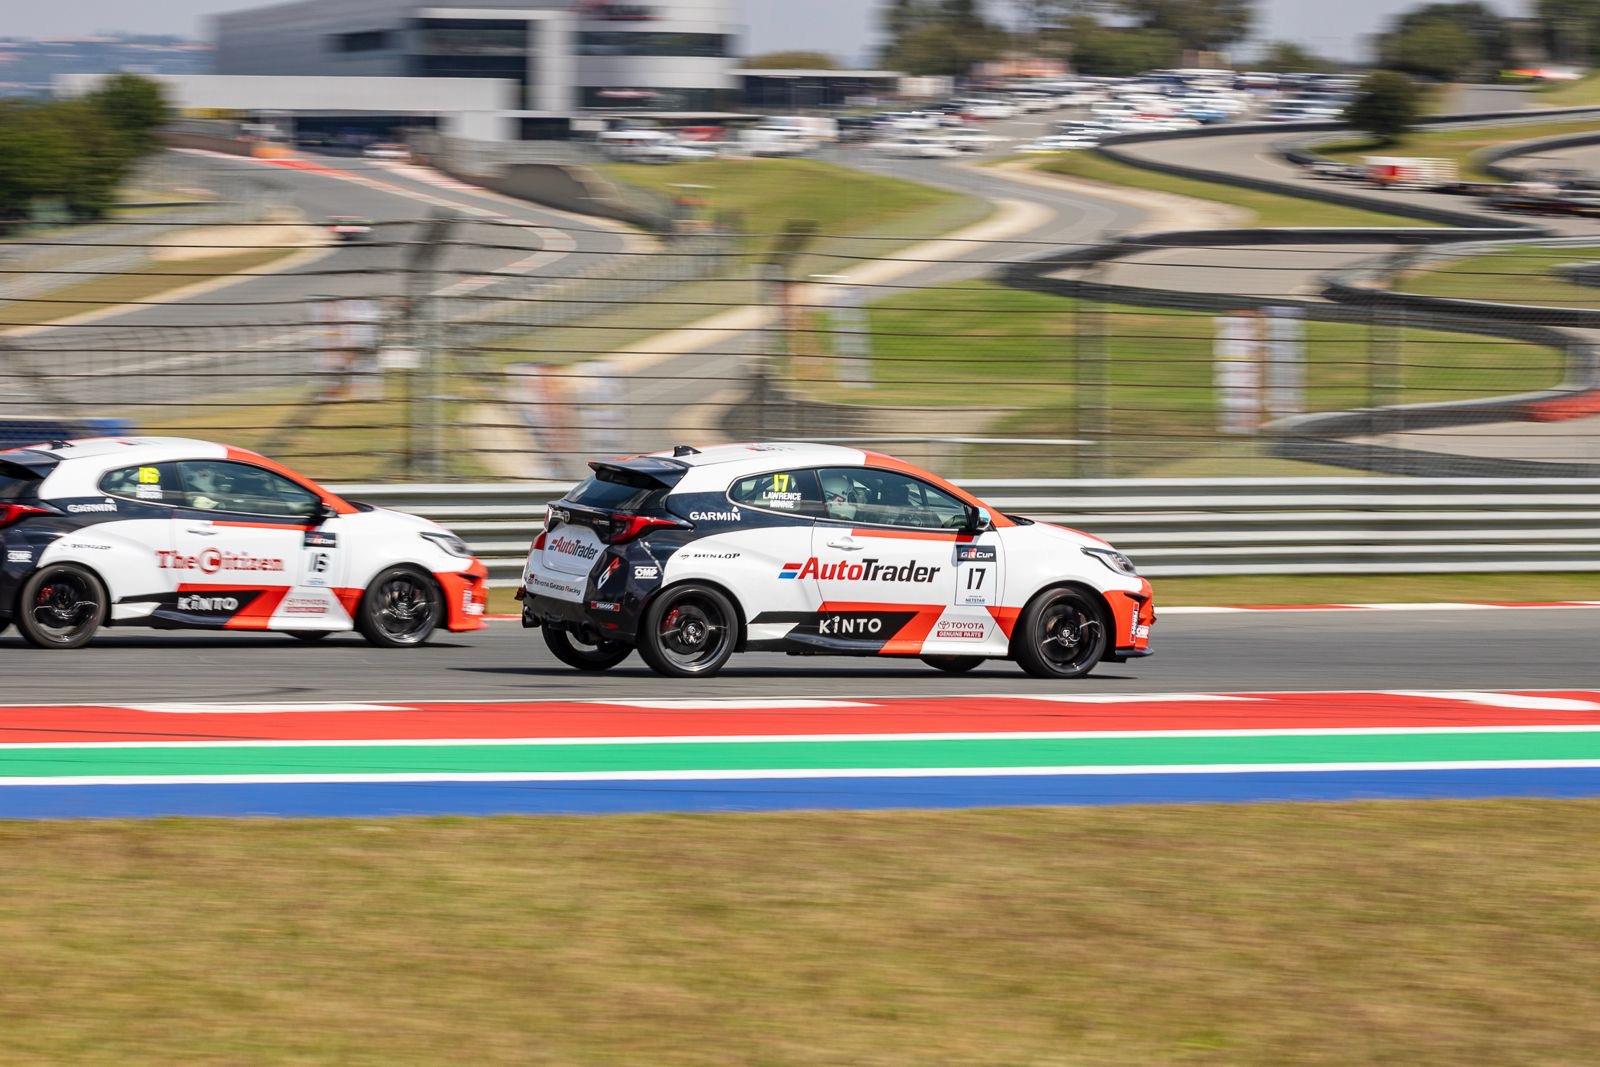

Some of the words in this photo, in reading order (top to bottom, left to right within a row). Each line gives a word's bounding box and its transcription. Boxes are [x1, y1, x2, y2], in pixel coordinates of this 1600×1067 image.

[773, 474, 789, 492] 17
[763, 492, 801, 500] LAWRENCE
[67, 504, 117, 513] GARMIN
[689, 511, 741, 521] GARMIN
[554, 536, 599, 560] AutoTrader
[634, 567, 659, 578] OMP
[798, 556, 941, 583] AutoTrader
[966, 567, 986, 590] 17
